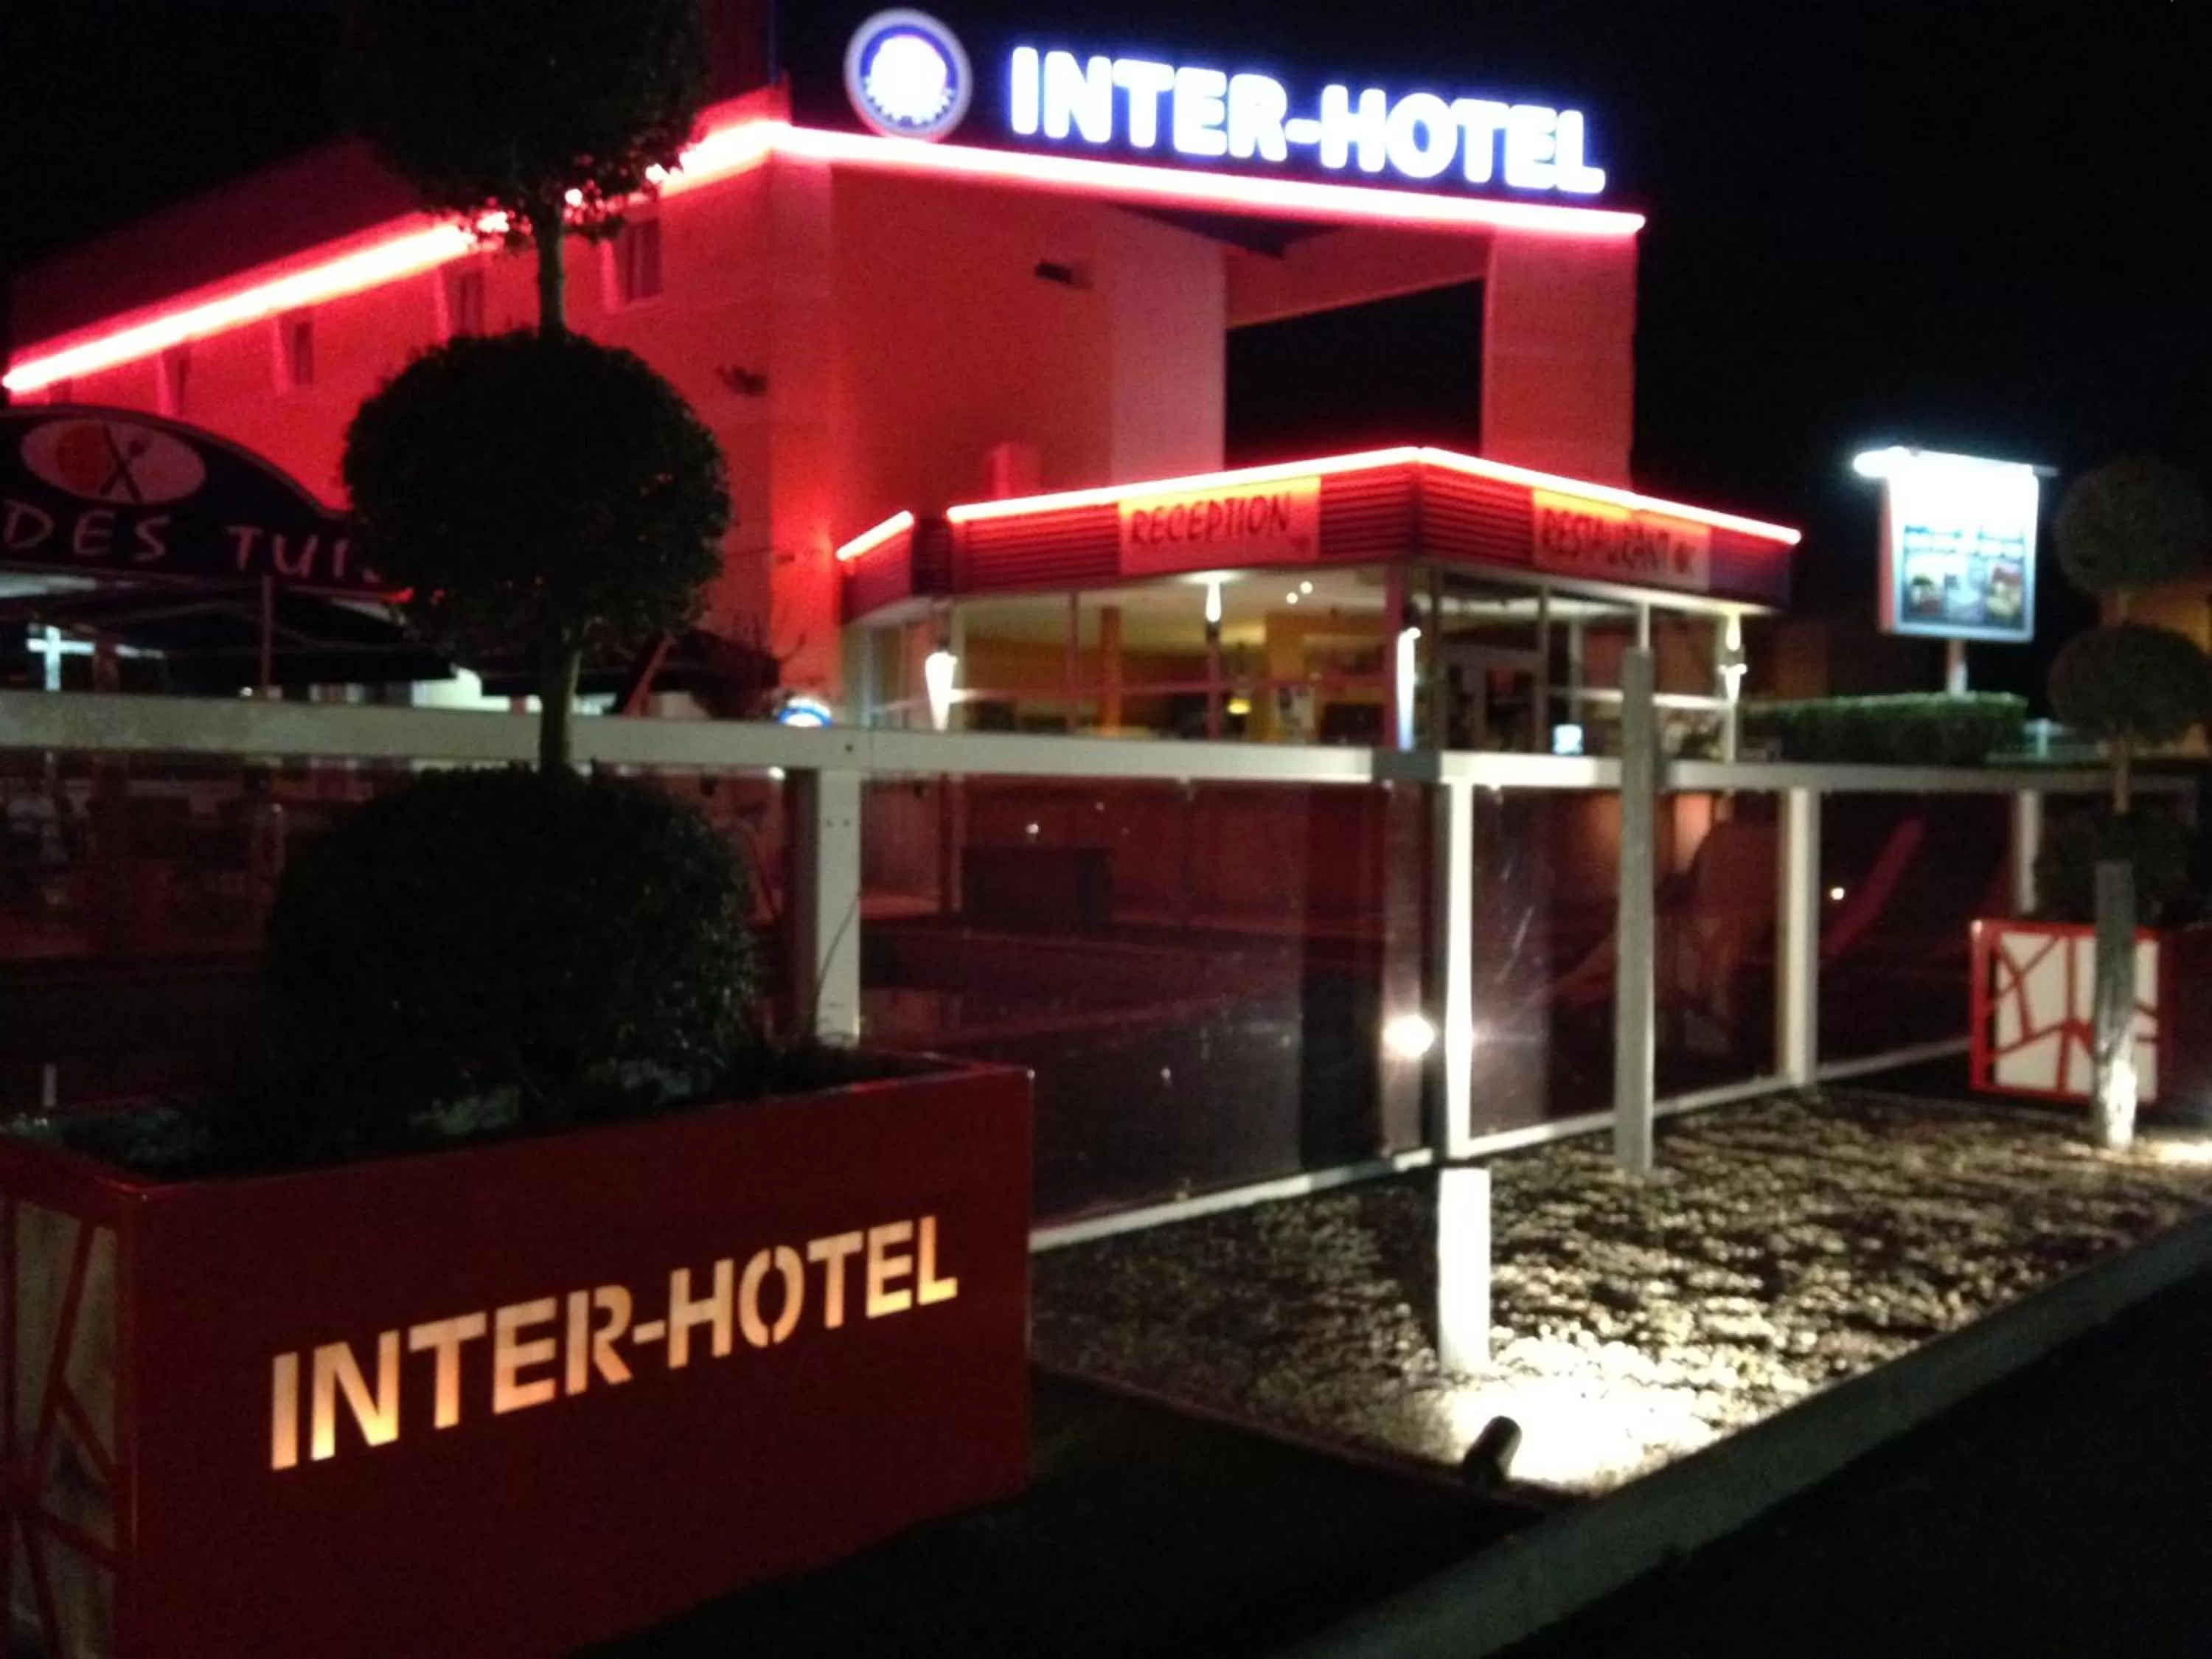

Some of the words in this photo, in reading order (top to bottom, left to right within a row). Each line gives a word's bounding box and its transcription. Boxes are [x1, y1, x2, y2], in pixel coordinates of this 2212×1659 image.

[1010, 46, 1606, 194] INTER-HOTEL
[4, 499, 171, 562] DES
[271, 1215, 958, 1472] INTER-HOTEL
